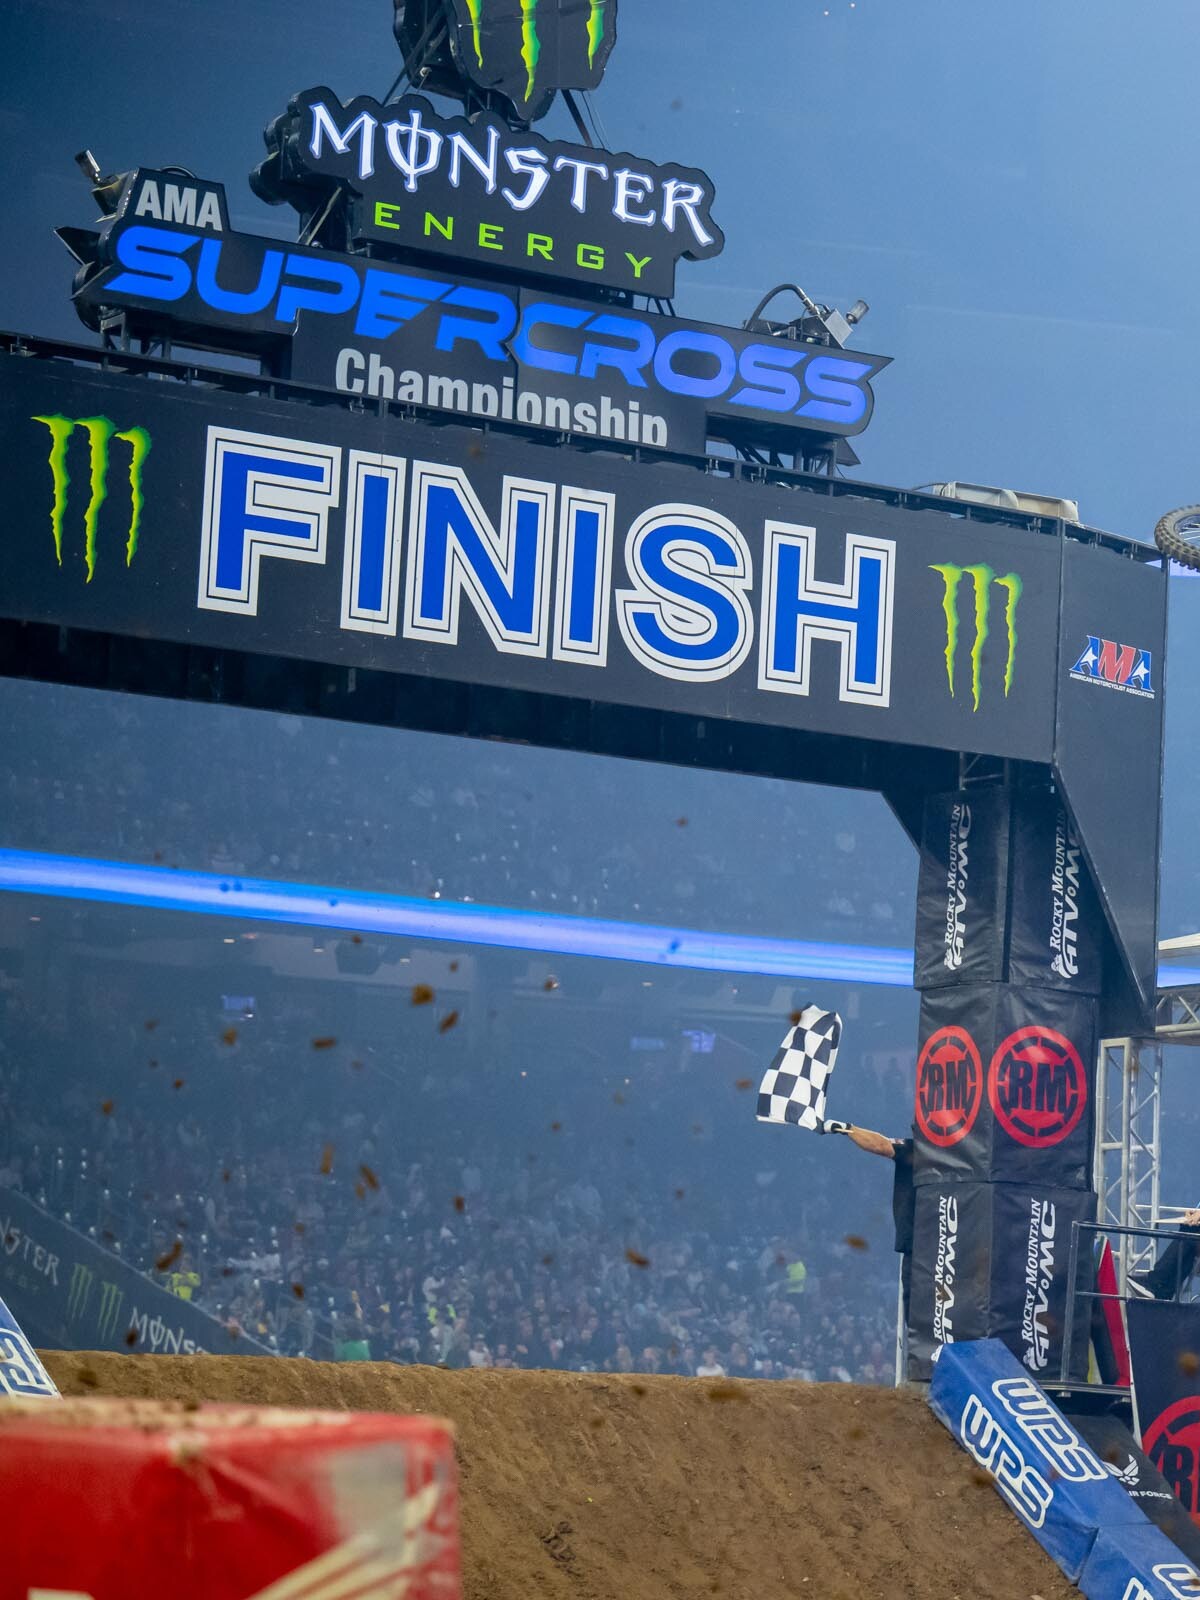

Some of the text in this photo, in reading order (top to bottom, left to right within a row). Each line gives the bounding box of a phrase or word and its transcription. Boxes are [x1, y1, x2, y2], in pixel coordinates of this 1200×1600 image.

[134, 179, 223, 232] AMA
[374, 201, 652, 278] ENERGY
[103, 225, 875, 424] SUPERCROSS
[335, 347, 668, 447] Championship
[197, 425, 897, 707] FINISH
[1069, 635, 1155, 692] AMA
[945, 804, 961, 944] ROCKY MOUNTAIN
[1050, 898, 1064, 951] ROCKY
[933, 1195, 948, 1342] ROCKY MOUNTAIN
[1022, 1198, 1041, 1343] ROCKY MOUNTAIN
[961, 1394, 1054, 1528] WPS
[992, 1377, 1108, 1482] WPS
